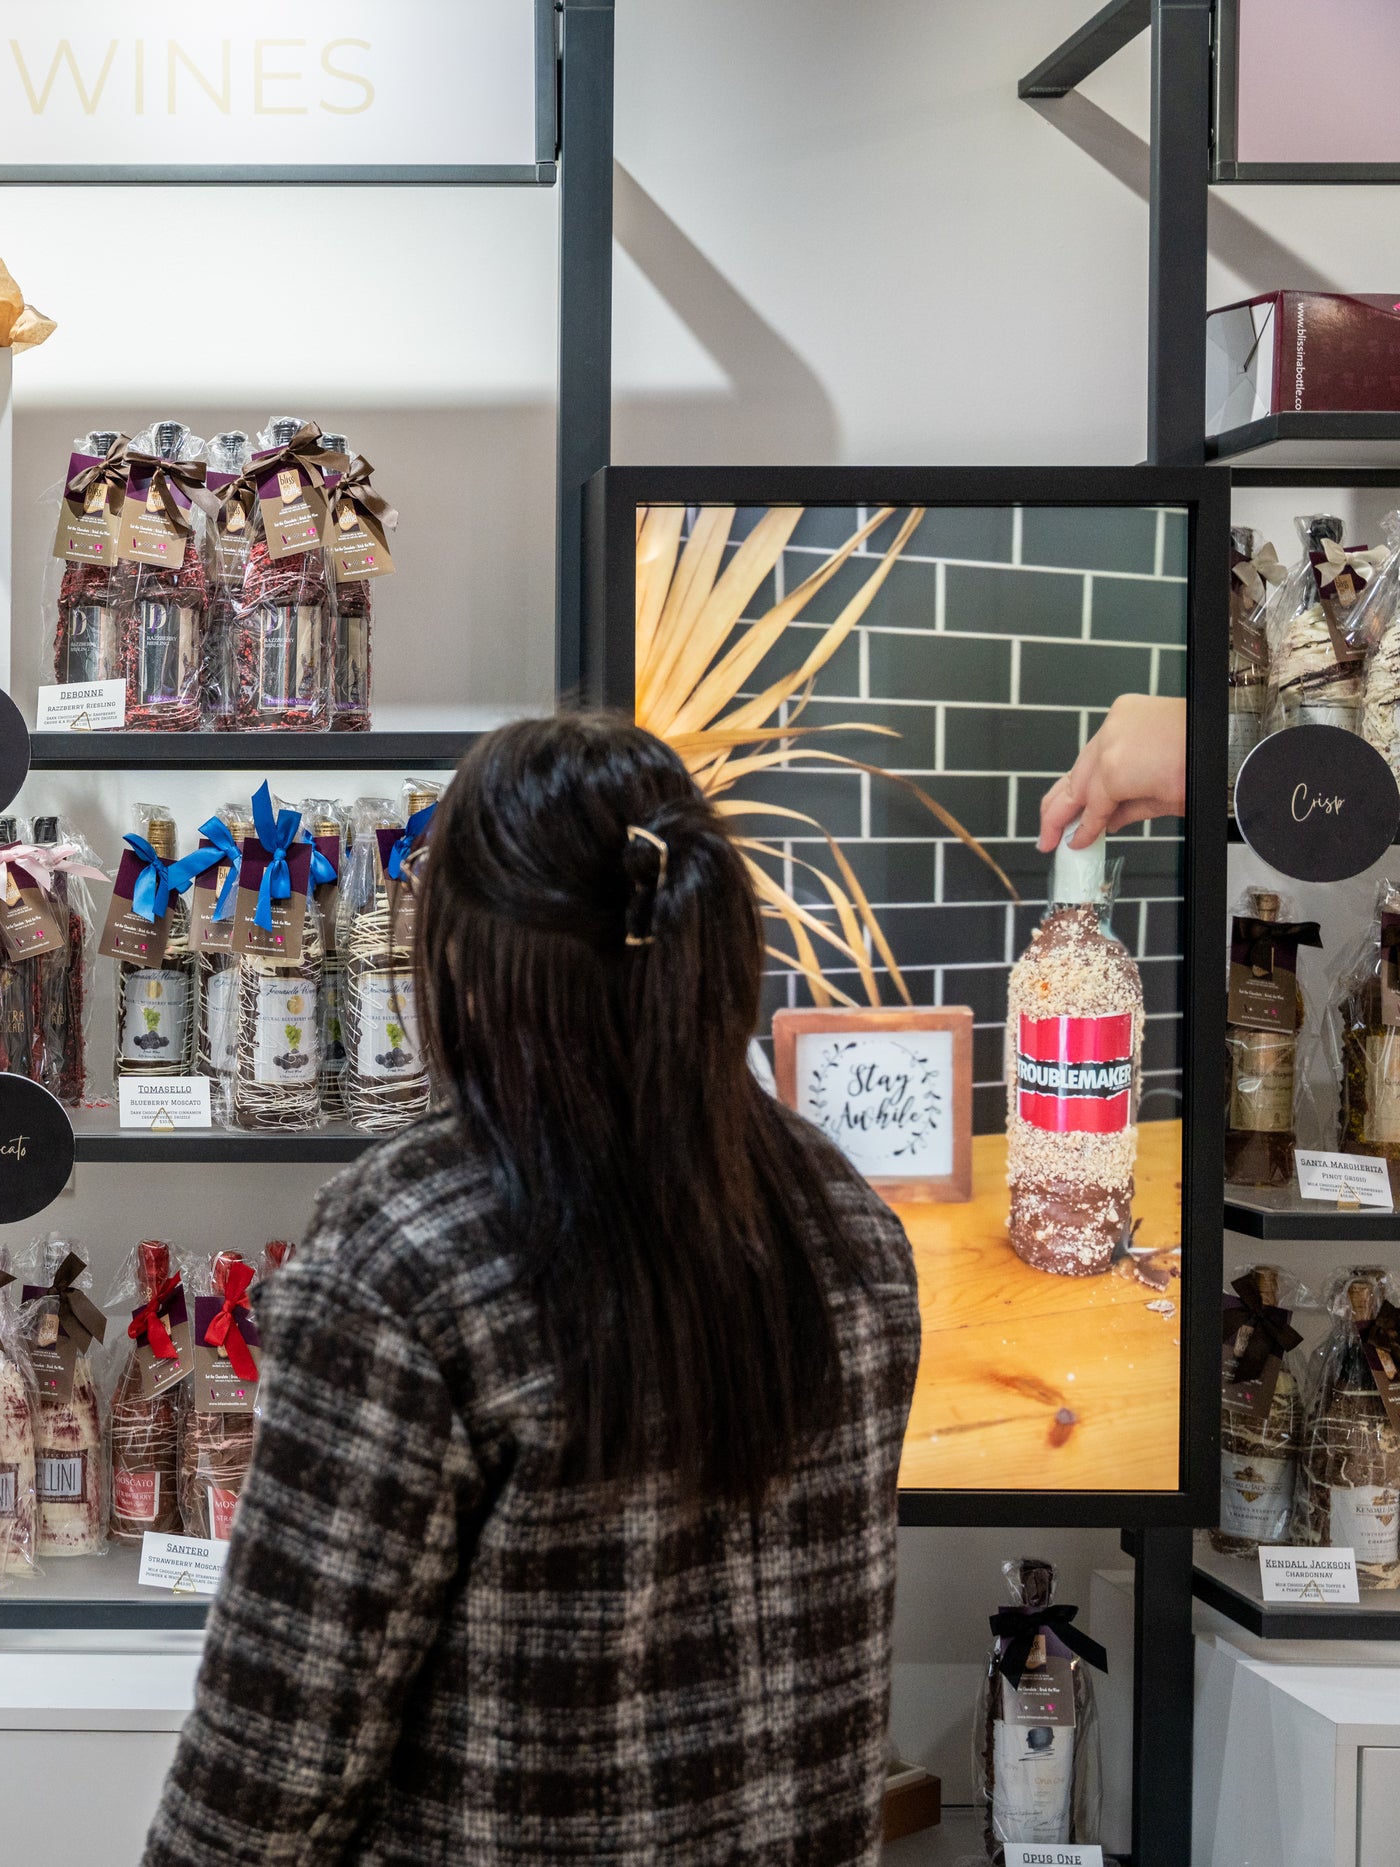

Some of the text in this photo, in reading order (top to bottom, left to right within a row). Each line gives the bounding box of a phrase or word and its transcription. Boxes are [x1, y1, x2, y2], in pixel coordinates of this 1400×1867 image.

[8, 38, 375, 116] WINES
[60, 688, 103, 700] DEBONNE
[47, 701, 116, 712] RAZZBERRY RIESLING
[1291, 782, 1345, 822] Crisp
[1017, 1058, 1131, 1089] TROUBLEMAKER
[137, 1085, 192, 1094] TOMASELLO
[847, 1063, 908, 1106] Stay
[833, 1096, 920, 1132] Awhile
[1300, 1158, 1384, 1174] SANTA MARGHERITA
[1321, 1172, 1367, 1183] PINOT GRIGIO
[166, 1543, 209, 1558] SANTERO
[147, 1555, 193, 1568] STRAWBERRY
[1265, 1559, 1351, 1570] KENDALL JACKSON
[1022, 1852, 1082, 1865] OPUS ONE
